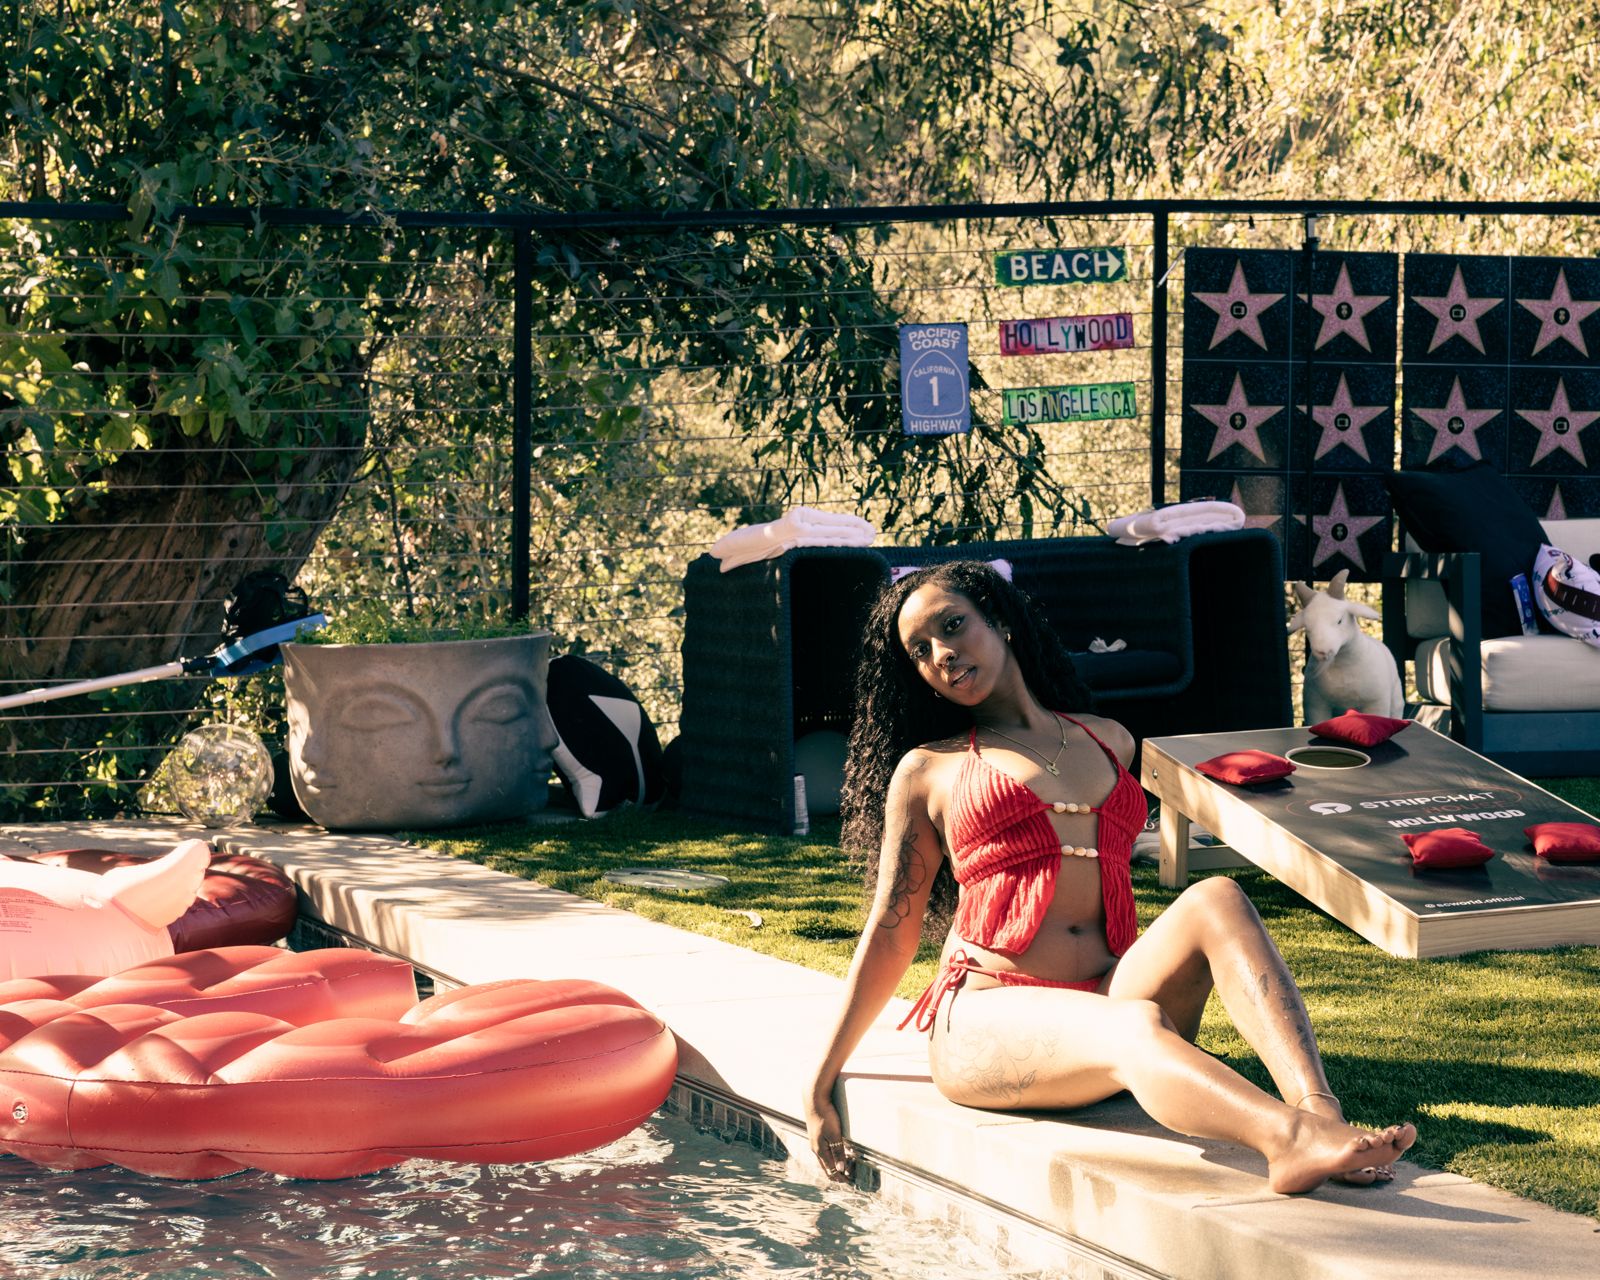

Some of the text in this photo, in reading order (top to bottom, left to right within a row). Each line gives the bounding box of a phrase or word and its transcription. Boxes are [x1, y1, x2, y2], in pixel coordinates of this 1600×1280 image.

[1010, 252, 1110, 281] BEACH
[908, 328, 961, 342] PACIFIC
[1005, 316, 1128, 351] HOLLYWOOD
[912, 338, 959, 351] COAST
[913, 365, 956, 378] CALIFORNIA
[929, 375, 940, 407] 1
[910, 420, 962, 432] HIGHWAY
[1359, 791, 1493, 809] STRIPCHAT
[1387, 809, 1526, 828] HOLLYWOOD
